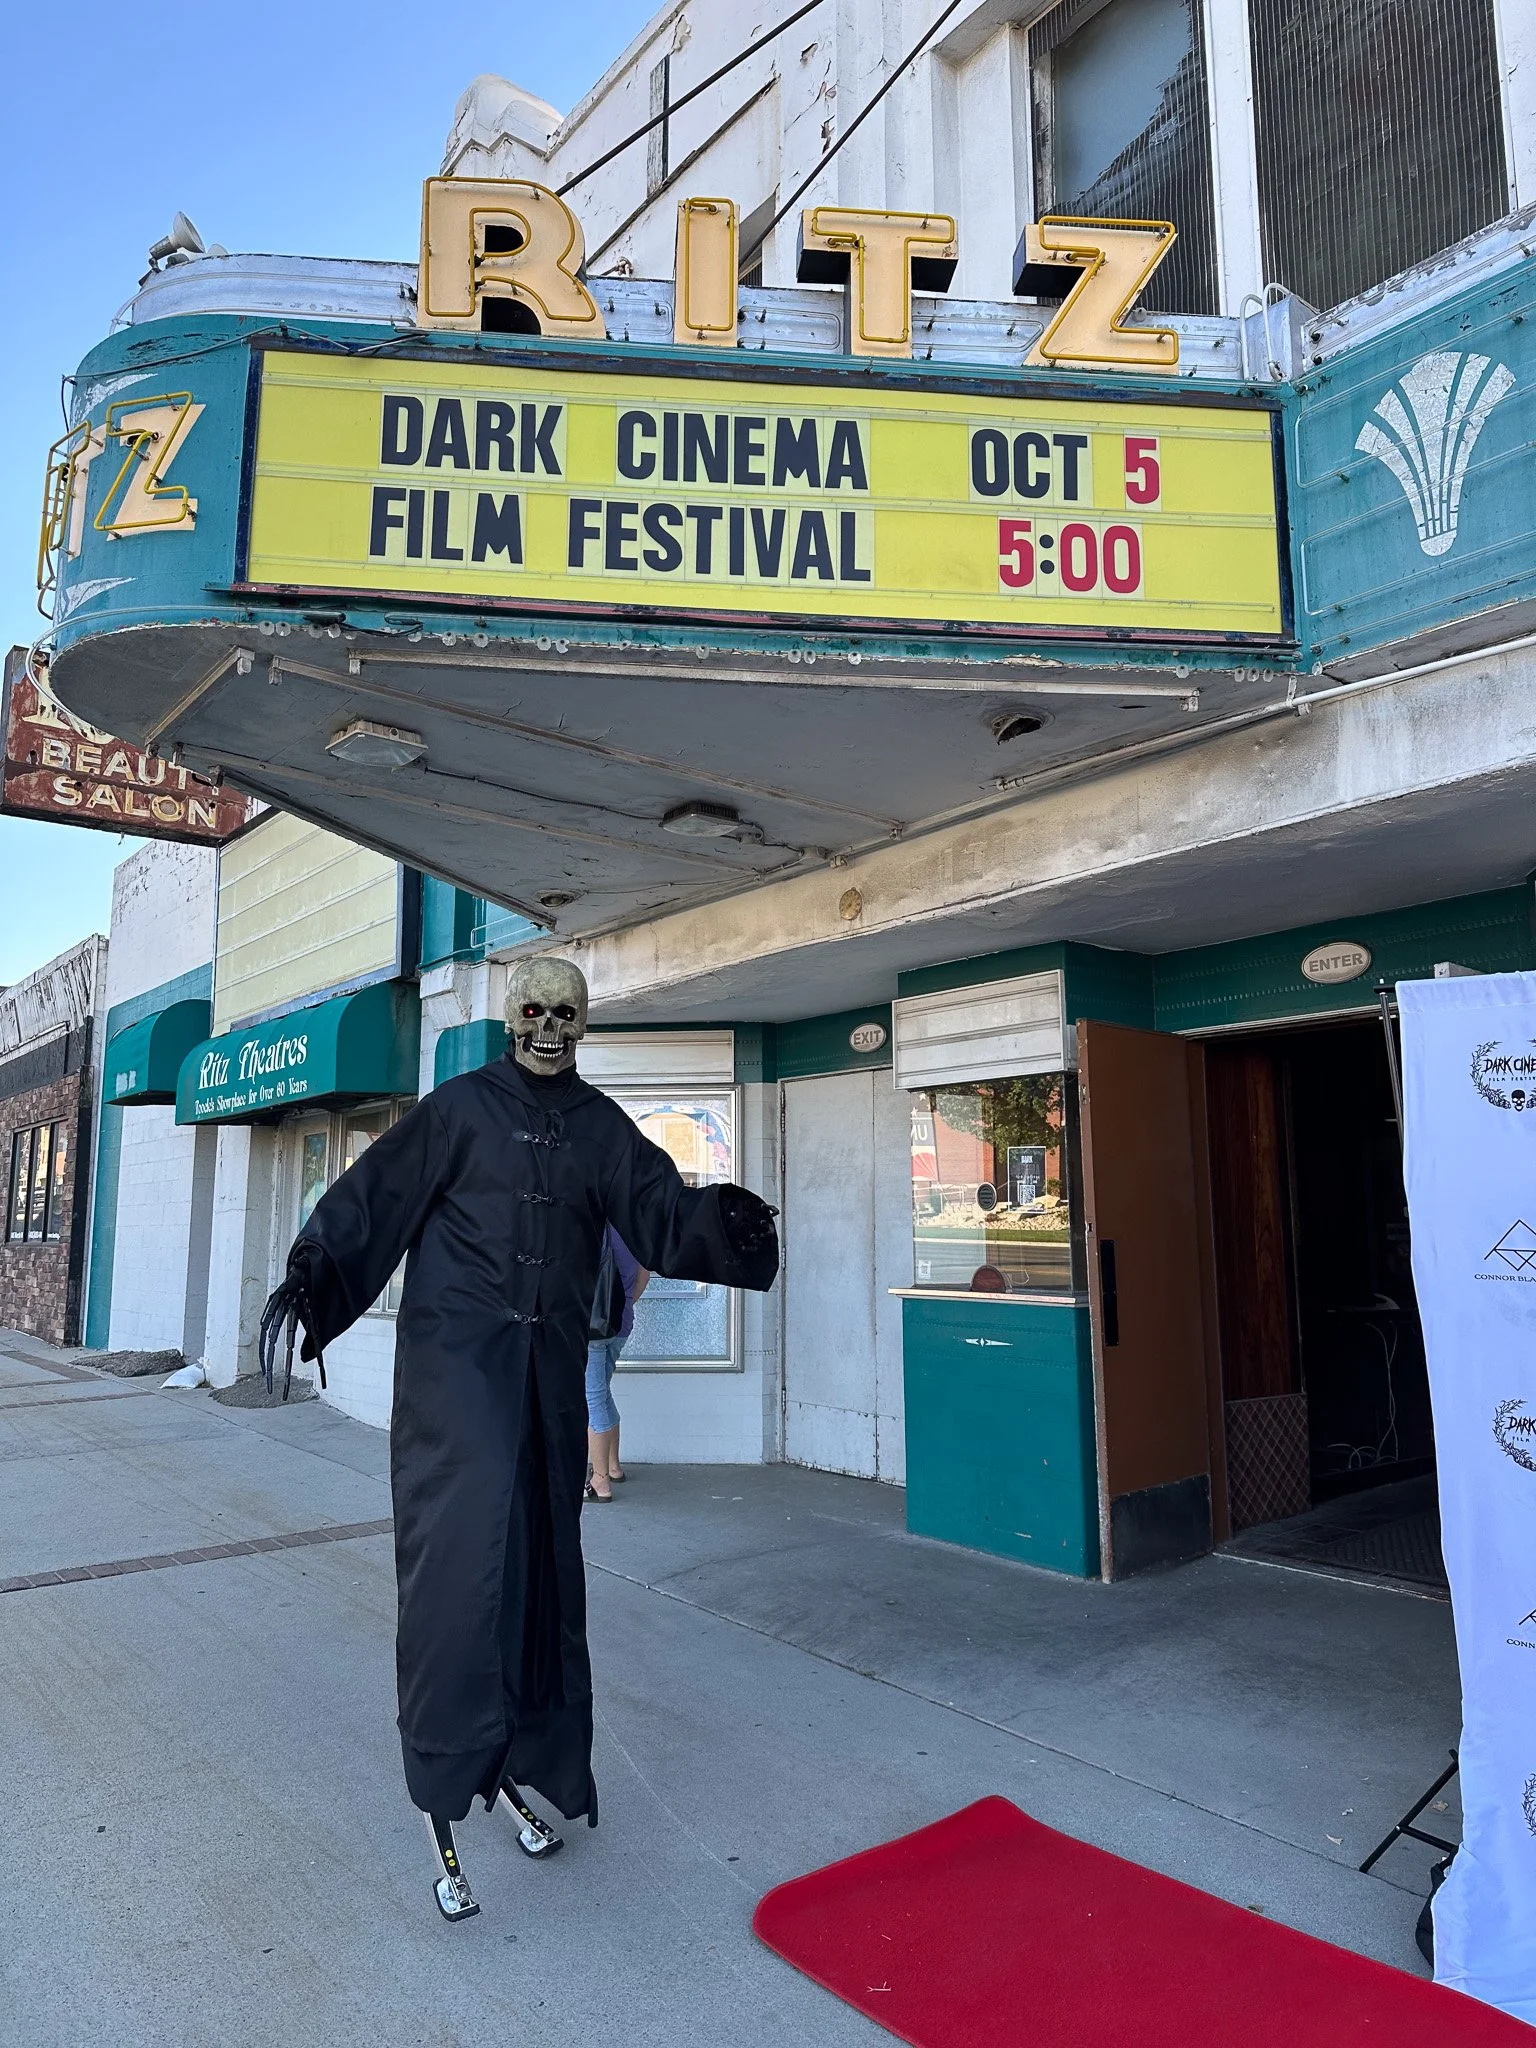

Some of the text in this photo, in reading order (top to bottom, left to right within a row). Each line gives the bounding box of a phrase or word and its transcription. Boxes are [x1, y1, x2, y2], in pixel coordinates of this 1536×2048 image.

[416, 178, 1180, 376] RITZ
[381, 395, 1161, 505] DARK CINEMA OCT 5
[370, 487, 1141, 594] FILM FESTIVAL 5:00
[41, 738, 219, 796] BEAUT
[53, 776, 217, 828] SALON
[1308, 953, 1364, 972] ENTER
[198, 1034, 307, 1089] Ritz Theatres
[853, 1030, 881, 1045] EXIT
[248, 1089, 258, 1105] for
[259, 1085, 275, 1102] Over
[276, 1081, 286, 1097] 60
[288, 1077, 308, 1095] Years
[1481, 1055, 1514, 1076] DARK
[1474, 1273, 1517, 1282] CONNOR
